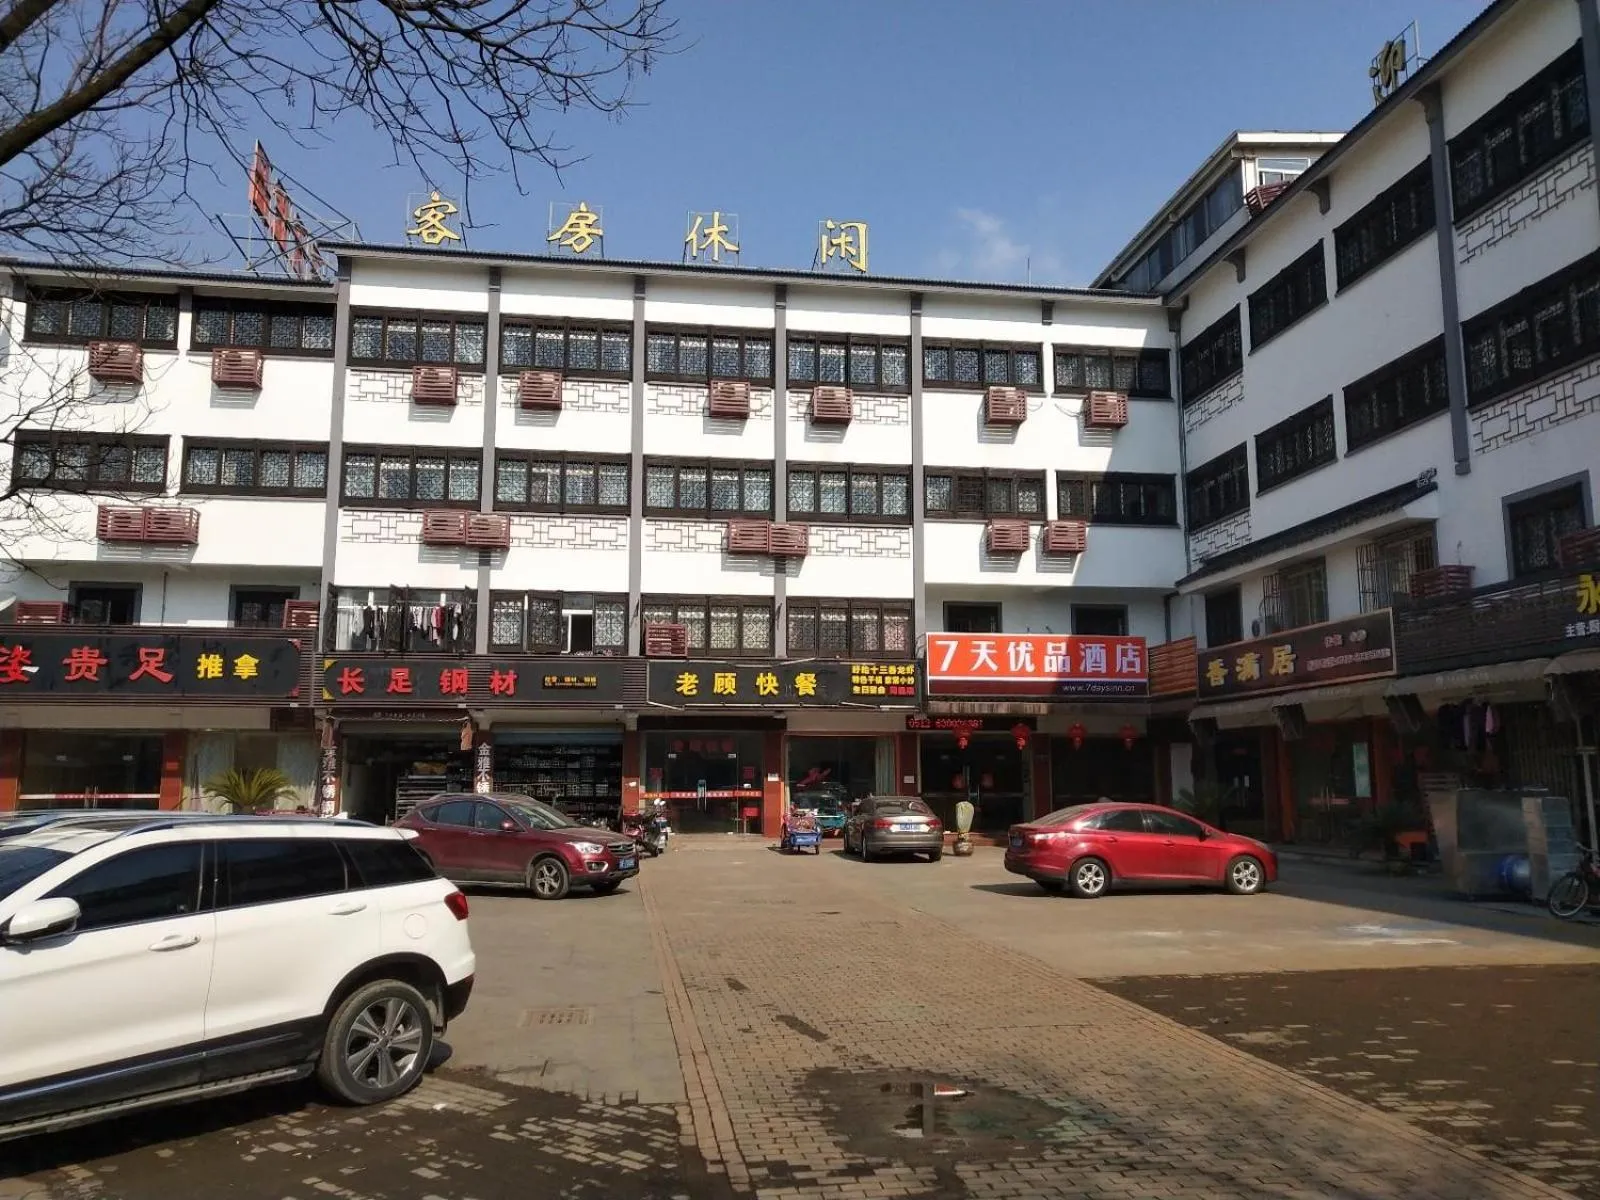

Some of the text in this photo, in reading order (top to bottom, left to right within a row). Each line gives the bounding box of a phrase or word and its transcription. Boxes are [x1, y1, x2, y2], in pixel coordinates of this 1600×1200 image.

[408, 191, 867, 271] 客房休闲
[197, 654, 259, 680] 推拿
[935, 640, 1141, 674] 7天优品酒店
[337, 667, 518, 696] 长足钢材
[676, 672, 816, 696] 老顾快餐
